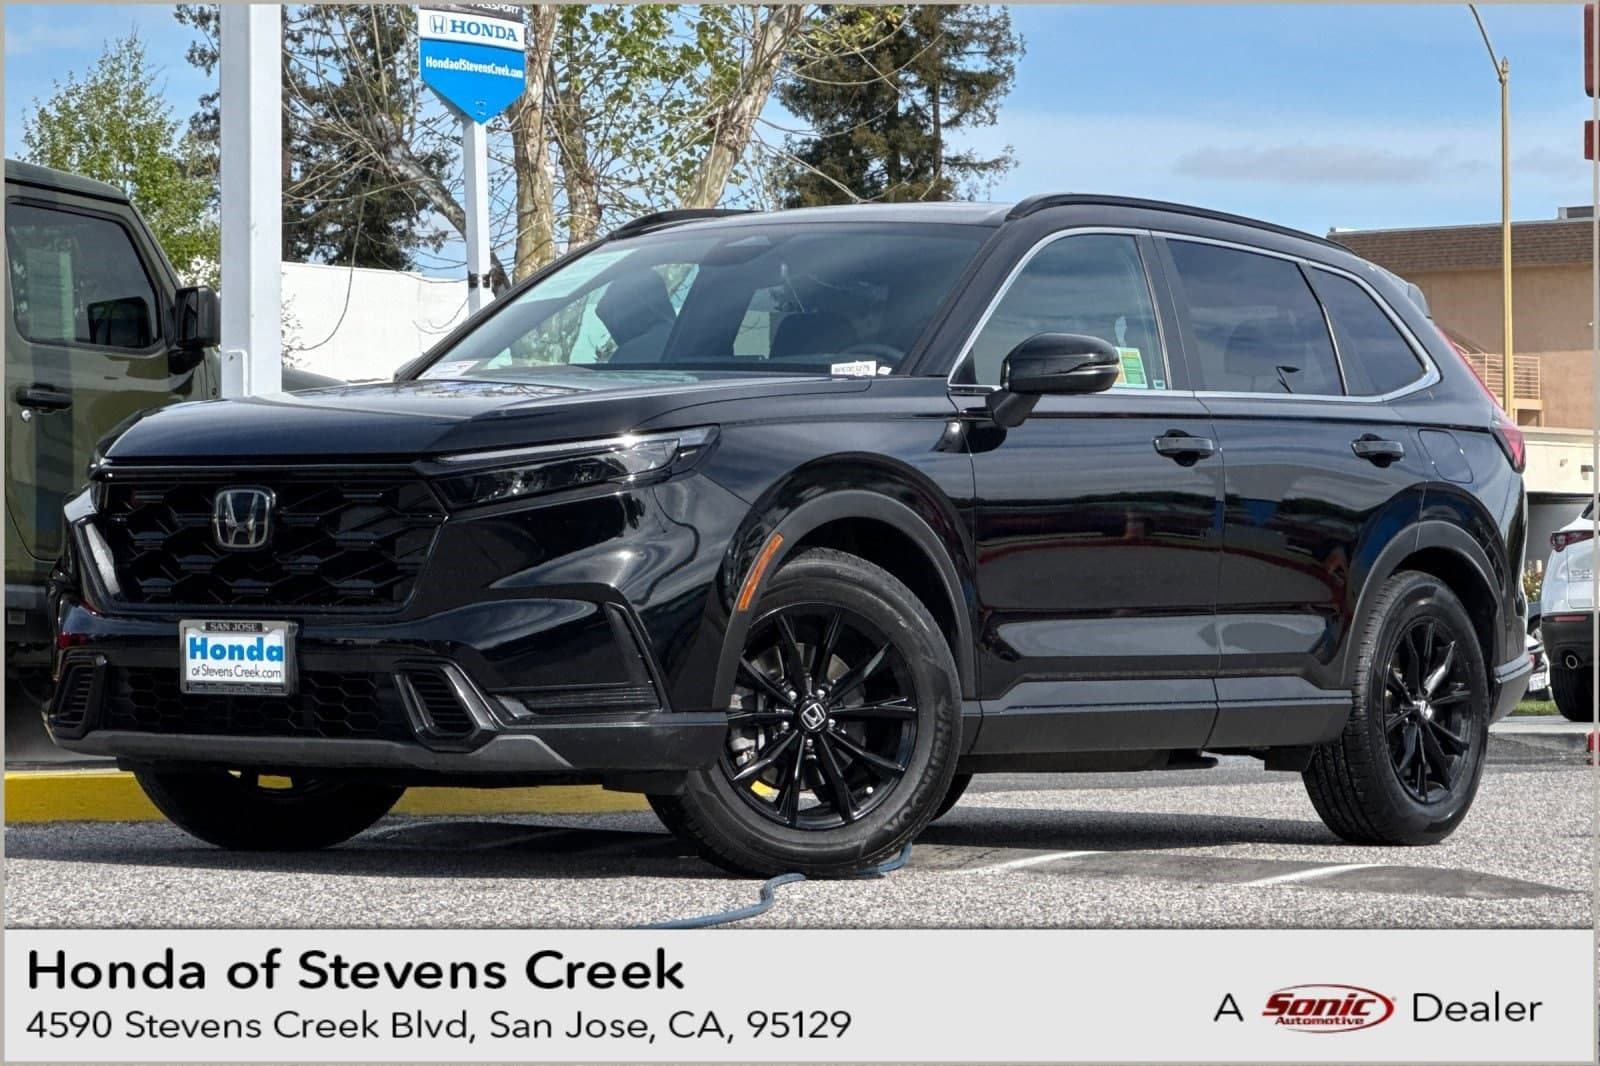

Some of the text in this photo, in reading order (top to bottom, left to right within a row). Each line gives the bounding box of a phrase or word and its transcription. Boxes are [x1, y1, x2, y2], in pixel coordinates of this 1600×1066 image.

[450, 19, 518, 42] HONDA
[425, 55, 524, 79] HondaofStevensCreek.com
[210, 622, 259, 632] SAN JOSE
[189, 636, 284, 662] Honda
[191, 666, 201, 677] of
